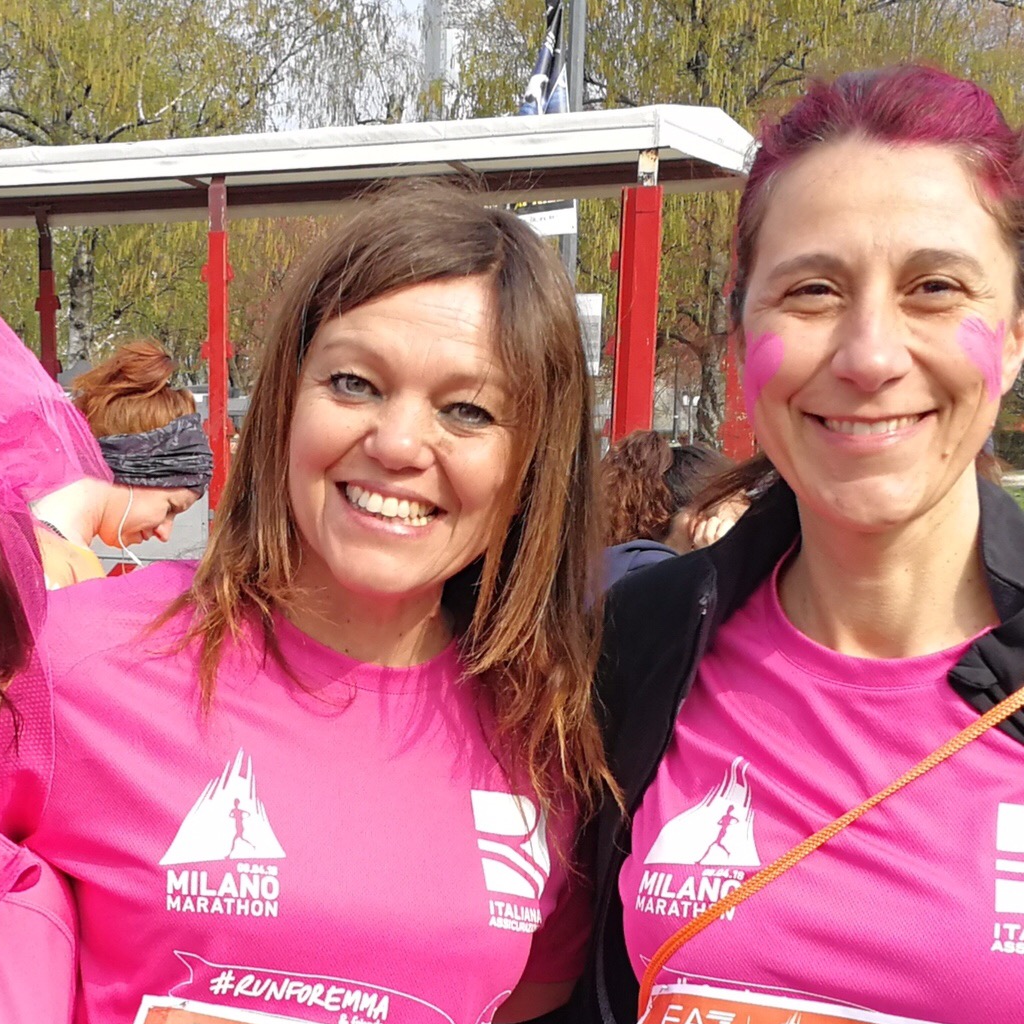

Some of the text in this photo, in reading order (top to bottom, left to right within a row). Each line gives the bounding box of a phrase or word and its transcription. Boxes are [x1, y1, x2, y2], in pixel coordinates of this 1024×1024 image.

[167, 869, 280, 901] MILANO
[166, 895, 278, 917] MARATHON
[489, 899, 542, 924] ITALIANA
[635, 895, 736, 920] MARATHN
[209, 970, 390, 1020] #RUNFOREMMA
